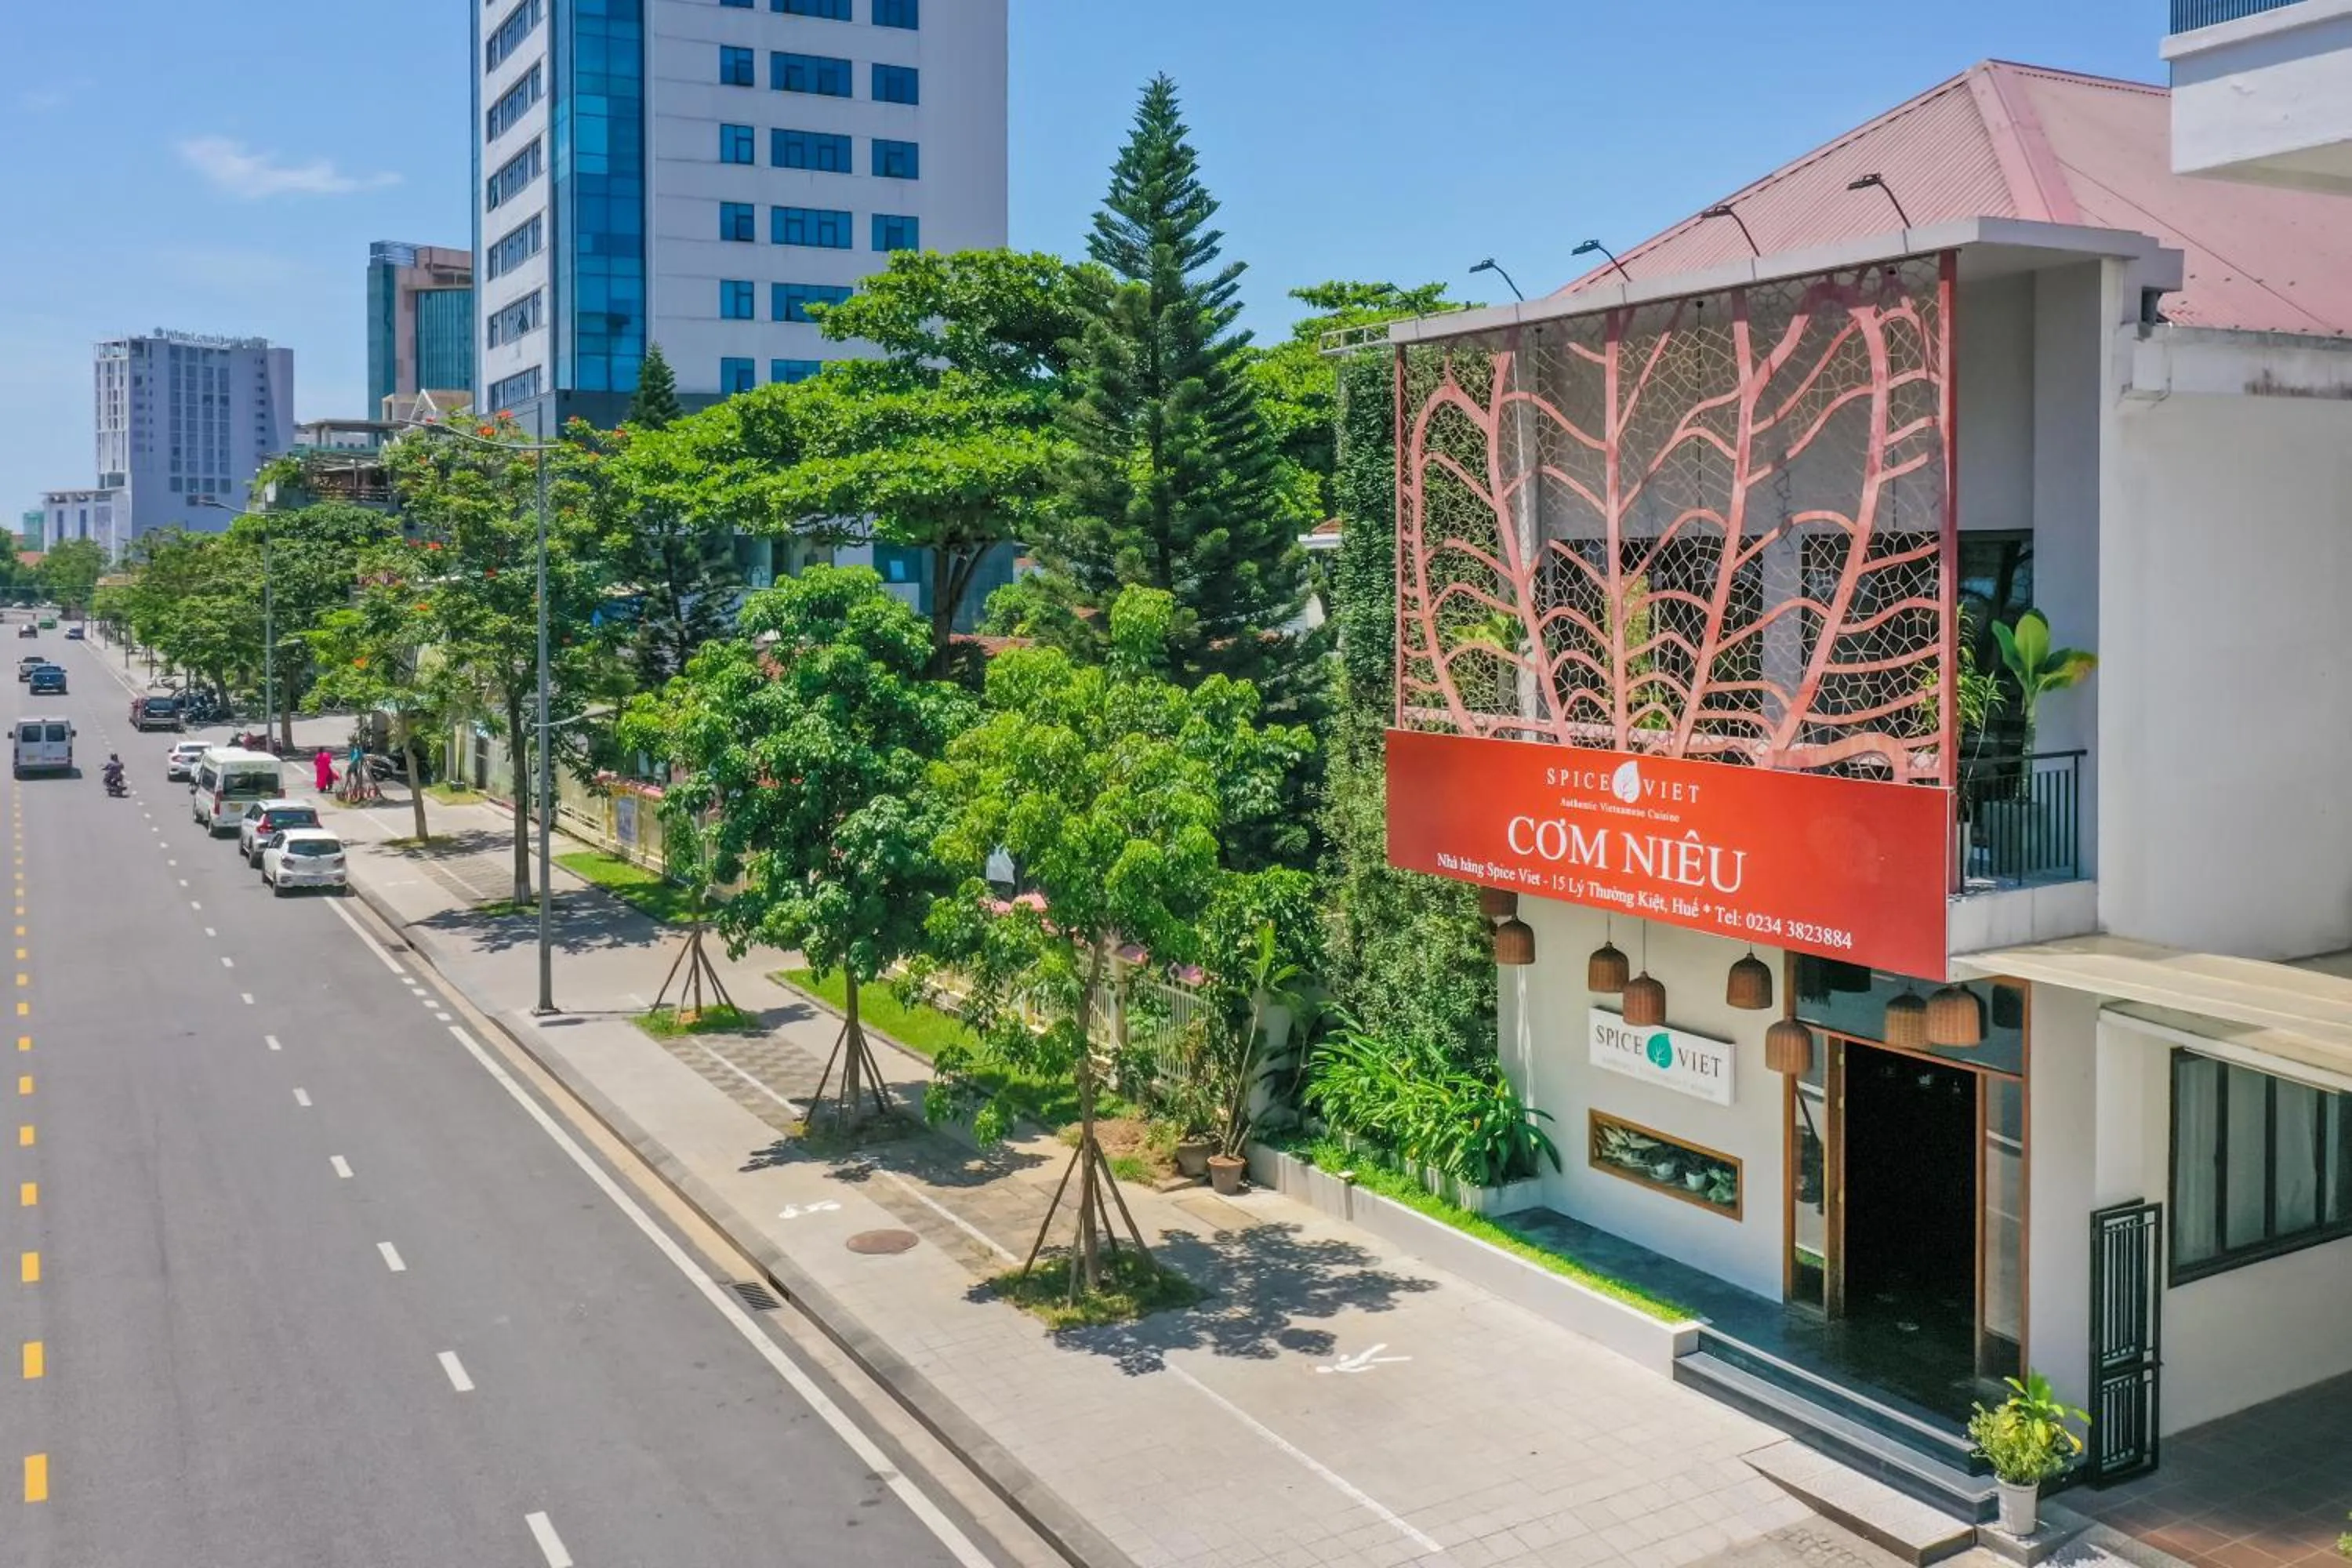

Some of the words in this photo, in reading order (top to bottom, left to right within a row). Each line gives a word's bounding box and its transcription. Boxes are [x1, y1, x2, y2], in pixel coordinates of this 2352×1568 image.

[1547, 768, 1610, 791] SPICE
[1643, 779, 1700, 804] VIET
[1560, 797, 1597, 811] Authentic
[1600, 802, 1646, 818] Vietnamese
[1647, 809, 1680, 822] Cuisine
[1508, 815, 1610, 870] CƠM
[1621, 829, 1748, 894] NIÊU
[1486, 862, 1515, 881] Spice
[1518, 867, 1541, 886] Viet
[1552, 873, 1566, 891] 15
[1569, 877, 1584, 897] Lý
[1672, 896, 1700, 917] Huế
[1715, 905, 1742, 927] Tel:
[1745, 912, 1782, 935] 0234
[1786, 920, 1853, 949] 3823884
[1595, 1025, 1642, 1056] SPICE
[1677, 1047, 1722, 1078] VIET
